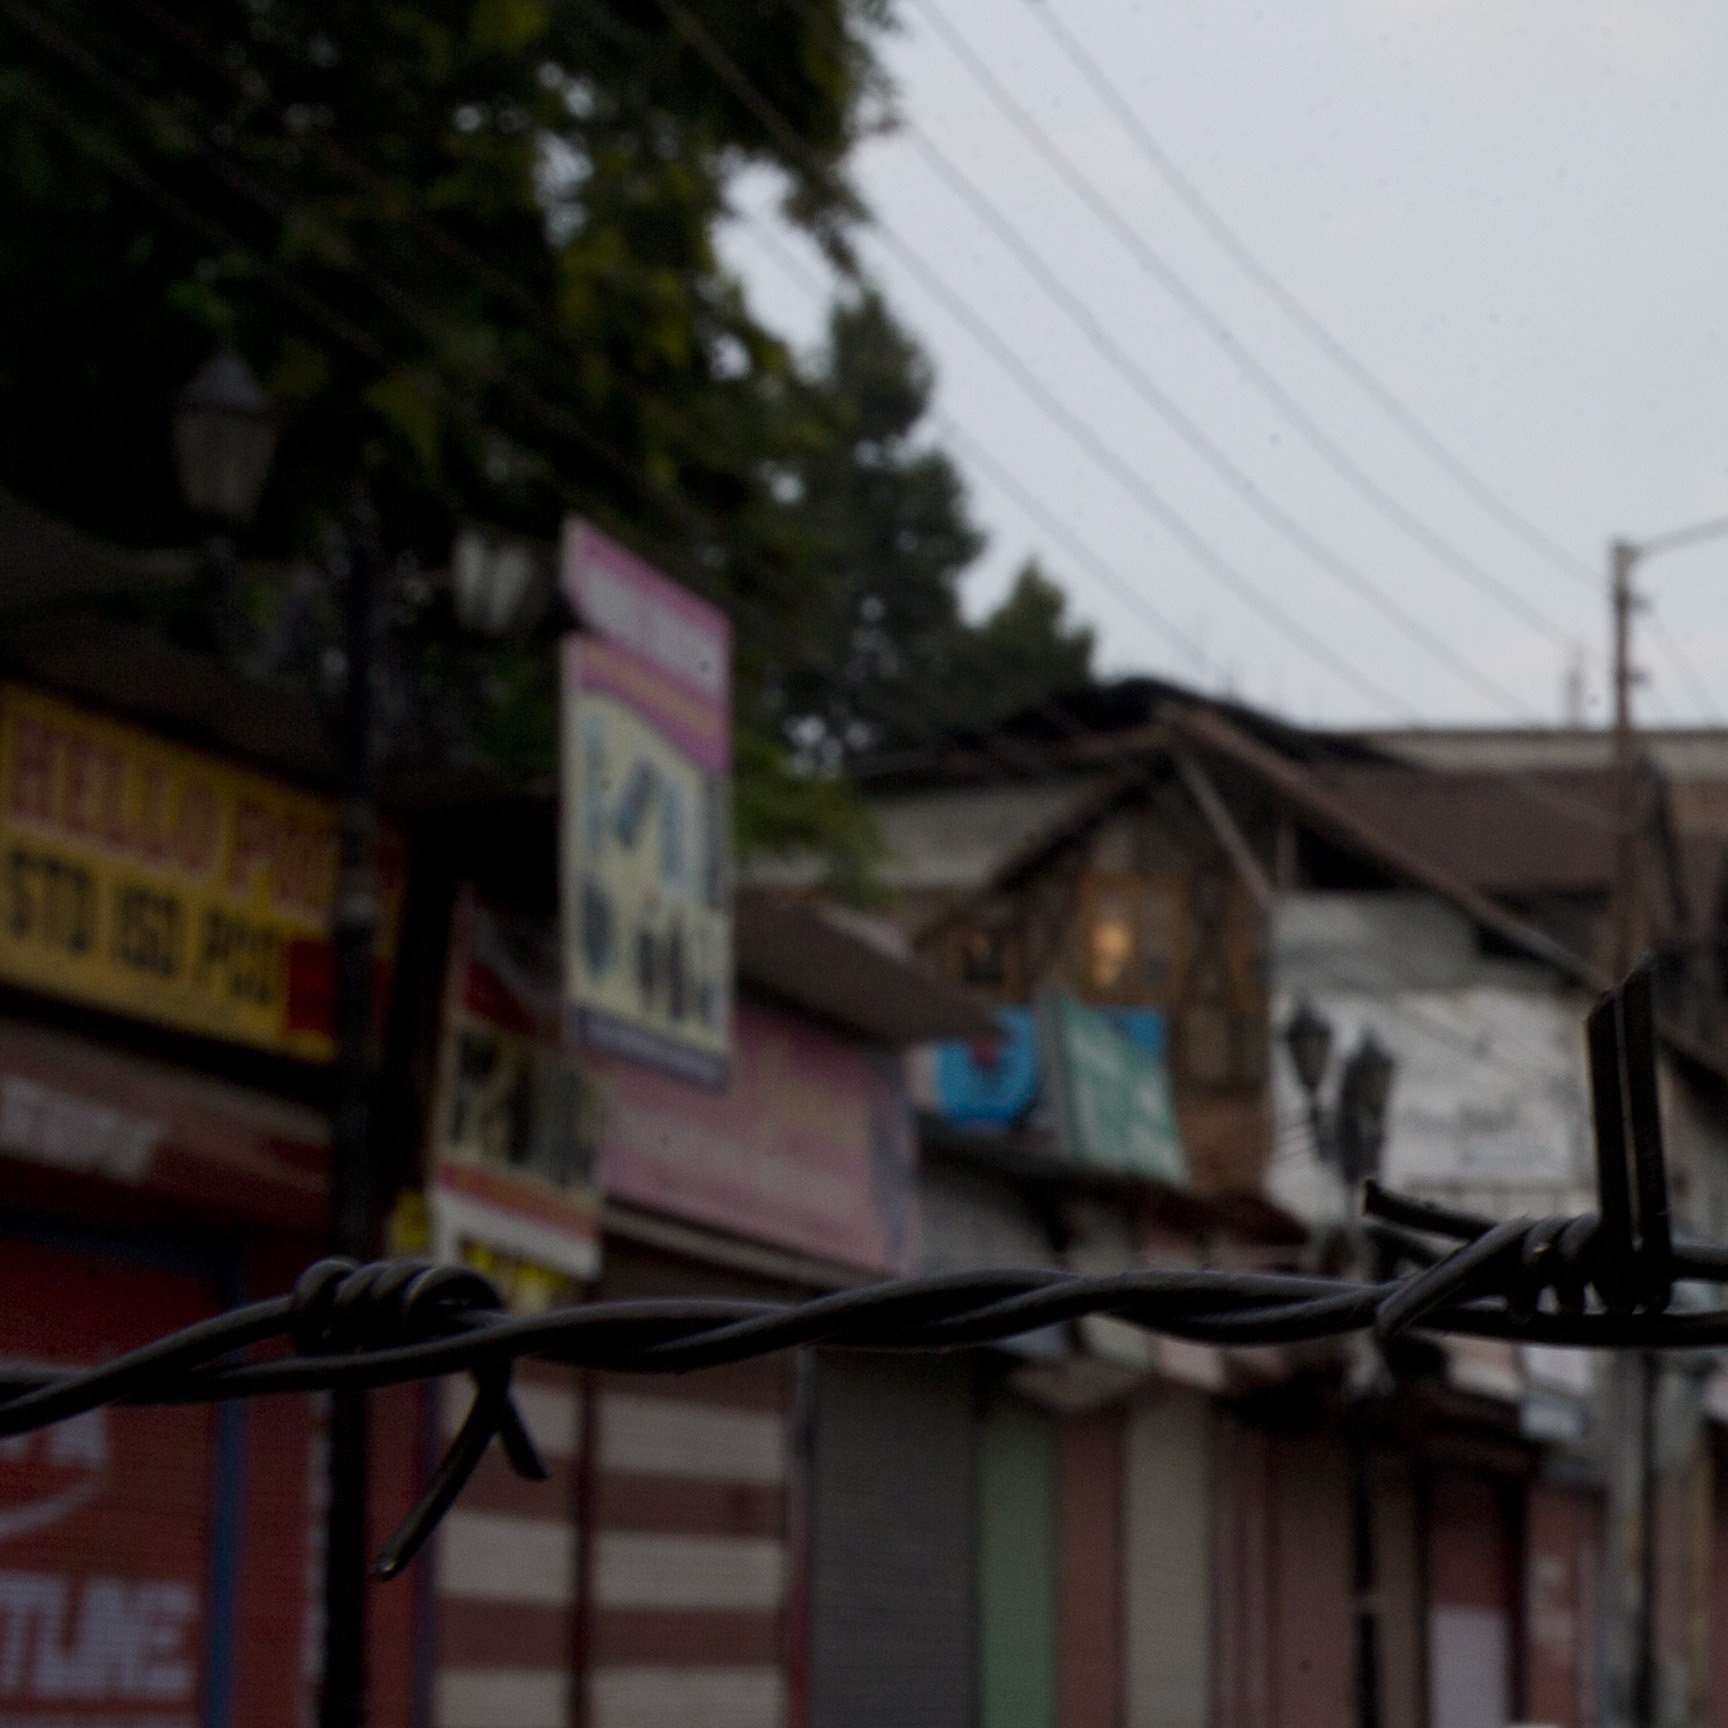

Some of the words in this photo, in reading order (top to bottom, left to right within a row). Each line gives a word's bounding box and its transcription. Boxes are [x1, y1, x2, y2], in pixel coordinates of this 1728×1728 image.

[12, 714, 215, 874] HELLO
[6, 845, 92, 956] STD
[113, 878, 182, 980] ISD
[196, 904, 281, 1009] PCO
